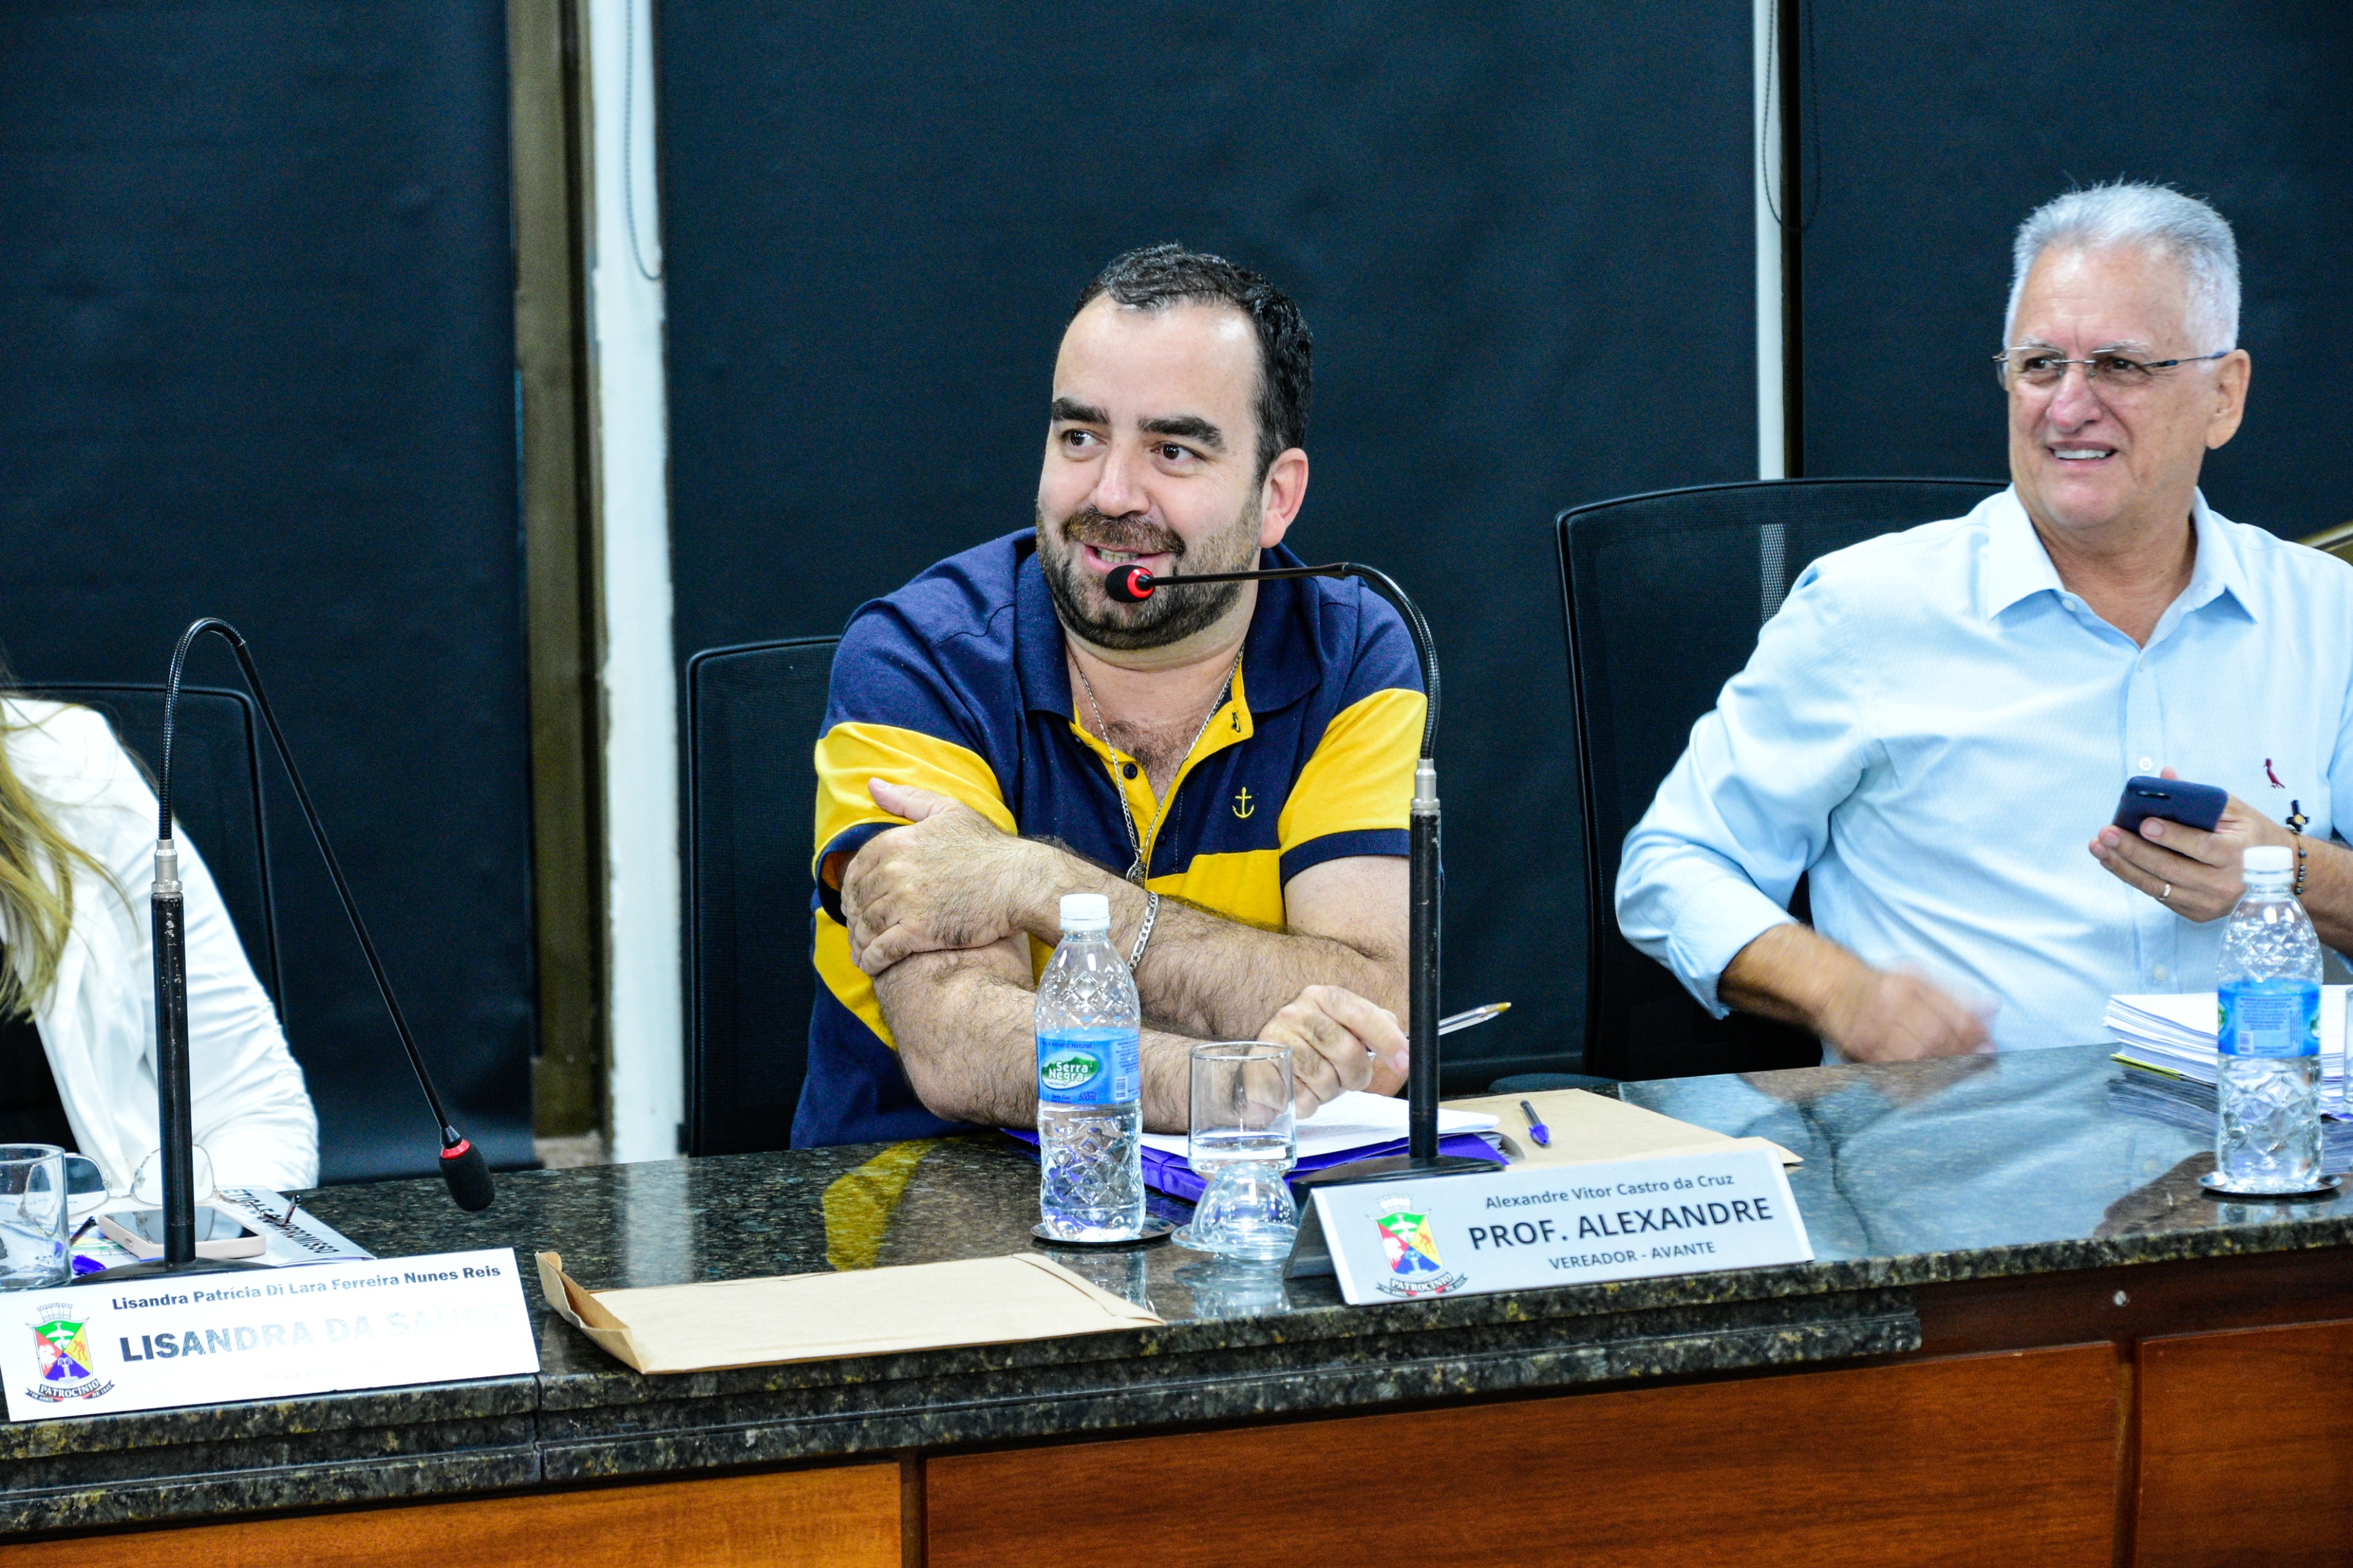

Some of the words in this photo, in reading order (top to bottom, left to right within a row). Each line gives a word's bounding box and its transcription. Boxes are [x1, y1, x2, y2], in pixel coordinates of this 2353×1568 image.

[1049, 1068, 1084, 1083] Negra
[1056, 1061, 1088, 1073] Serra
[1079, 1093, 1097, 1101] 500ml
[1486, 1191, 1570, 1209] Alexandre
[1572, 1186, 1612, 1200] Vitor
[1617, 1181, 1669, 1196] Castro
[1674, 1177, 1694, 1190] da
[1697, 1175, 1734, 1188] Cruz
[1468, 1219, 1568, 1250] PROF.
[1579, 1197, 1774, 1240] ALEXANDRE
[1549, 1250, 1638, 1270] VEREADOR
[1651, 1241, 1716, 1260] AVANTE
[112, 1293, 188, 1310] Lisandra
[193, 1286, 261, 1303] Patrícia
[266, 1283, 284, 1296] Di
[289, 1278, 327, 1295] Lara
[332, 1274, 400, 1290] Ferreira
[404, 1270, 459, 1284] Nunes
[462, 1265, 501, 1279] Reis
[119, 1321, 315, 1363] LISANDRA
[325, 1315, 376, 1342] DA
